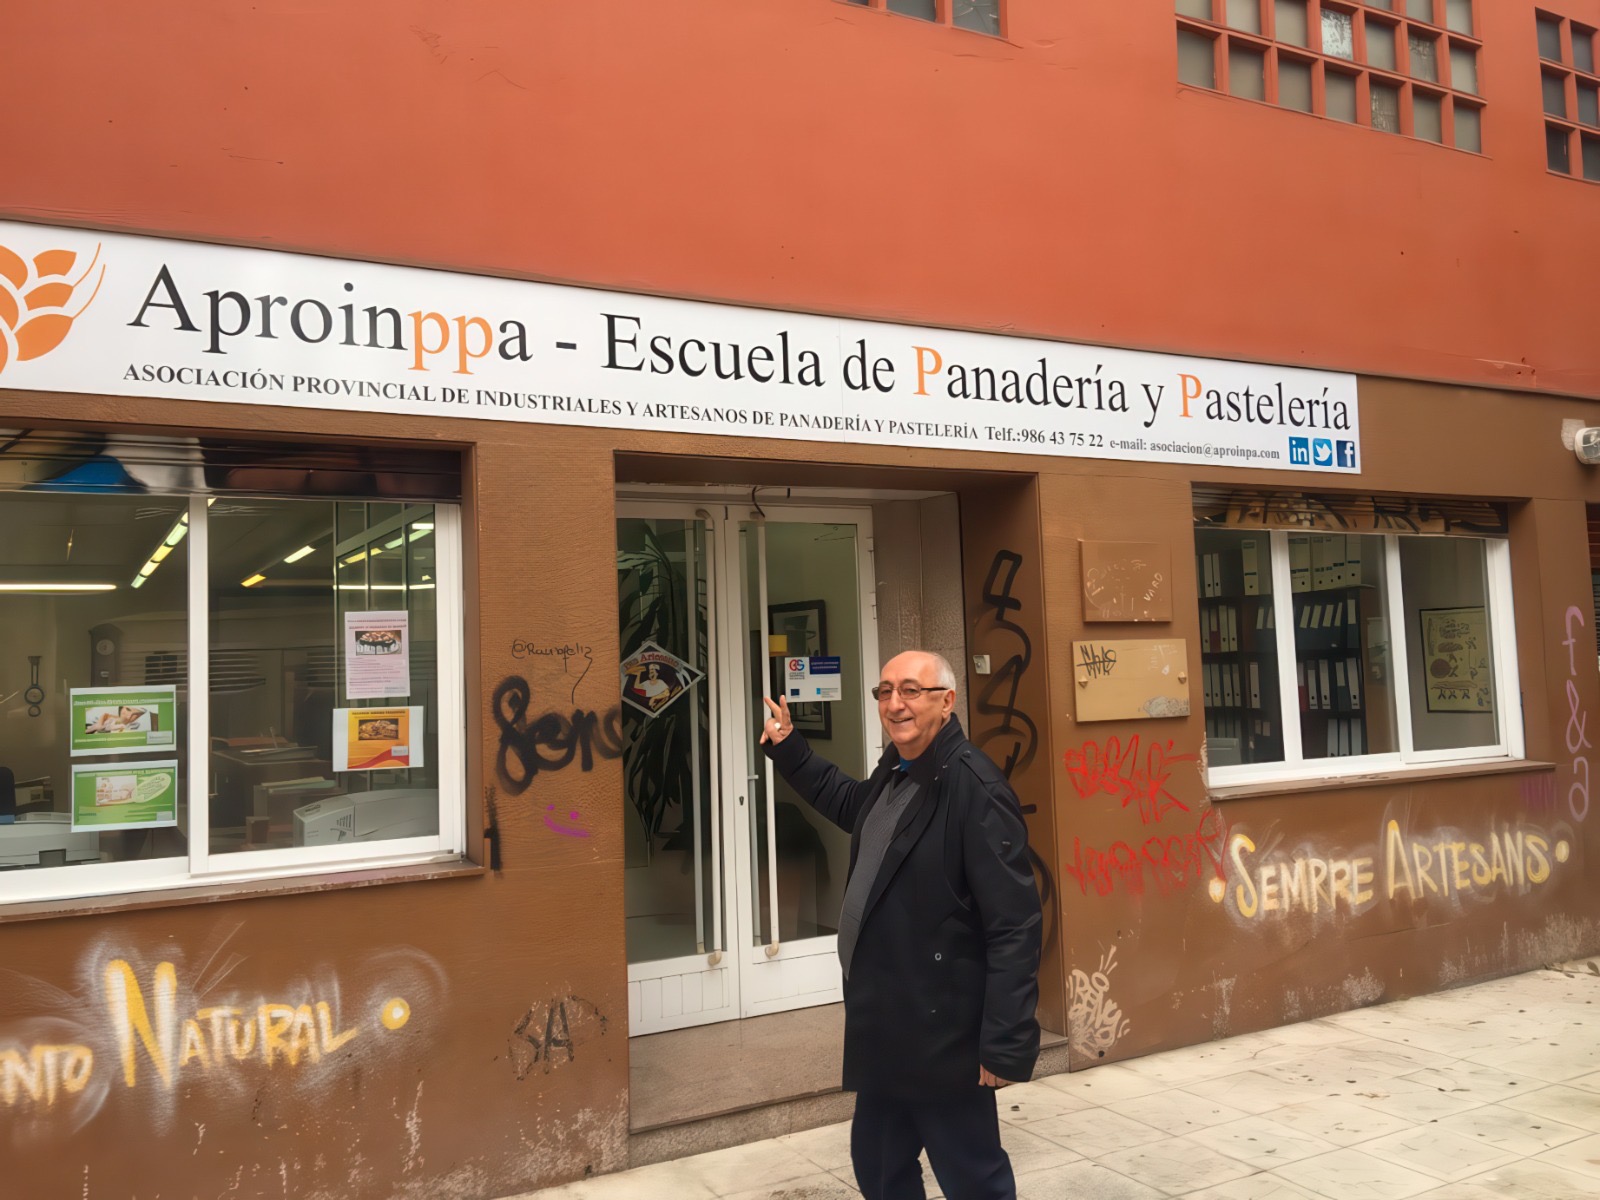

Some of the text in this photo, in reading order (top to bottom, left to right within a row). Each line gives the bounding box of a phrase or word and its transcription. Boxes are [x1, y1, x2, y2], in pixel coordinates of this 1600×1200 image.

[127, 263, 533, 375] Aproinppa
[600, 313, 826, 388] Escuela
[842, 338, 896, 393] de
[911, 345, 1130, 413] Panadería
[1140, 383, 1165, 429] y
[1177, 373, 1351, 431] Pastelería
[123, 363, 285, 391] ASOCIACIÓN
[291, 374, 436, 402] PROVINCIAL
[441, 387, 470, 405] DE
[475, 389, 623, 417] INDUSTRIALES
[626, 401, 640, 417] Y
[642, 403, 748, 425] ARTESANOS
[752, 411, 775, 426] DE
[779, 411, 871, 433] PANADERÍA
[874, 419, 885, 433] Y
[889, 421, 979, 441] PASTELERÍA
[1049, 432, 1065, 446] 43
[1068, 433, 1085, 448] 75
[1088, 434, 1104, 449] 22
[1109, 439, 1148, 452] e-mail:
[1150, 440, 1281, 461] asociacion@aproinpa.com
[1230, 834, 1374, 919] SEMPRE
[1386, 819, 1551, 903] ARTESANS
[0, 959, 360, 1105] NTO NATURAL
